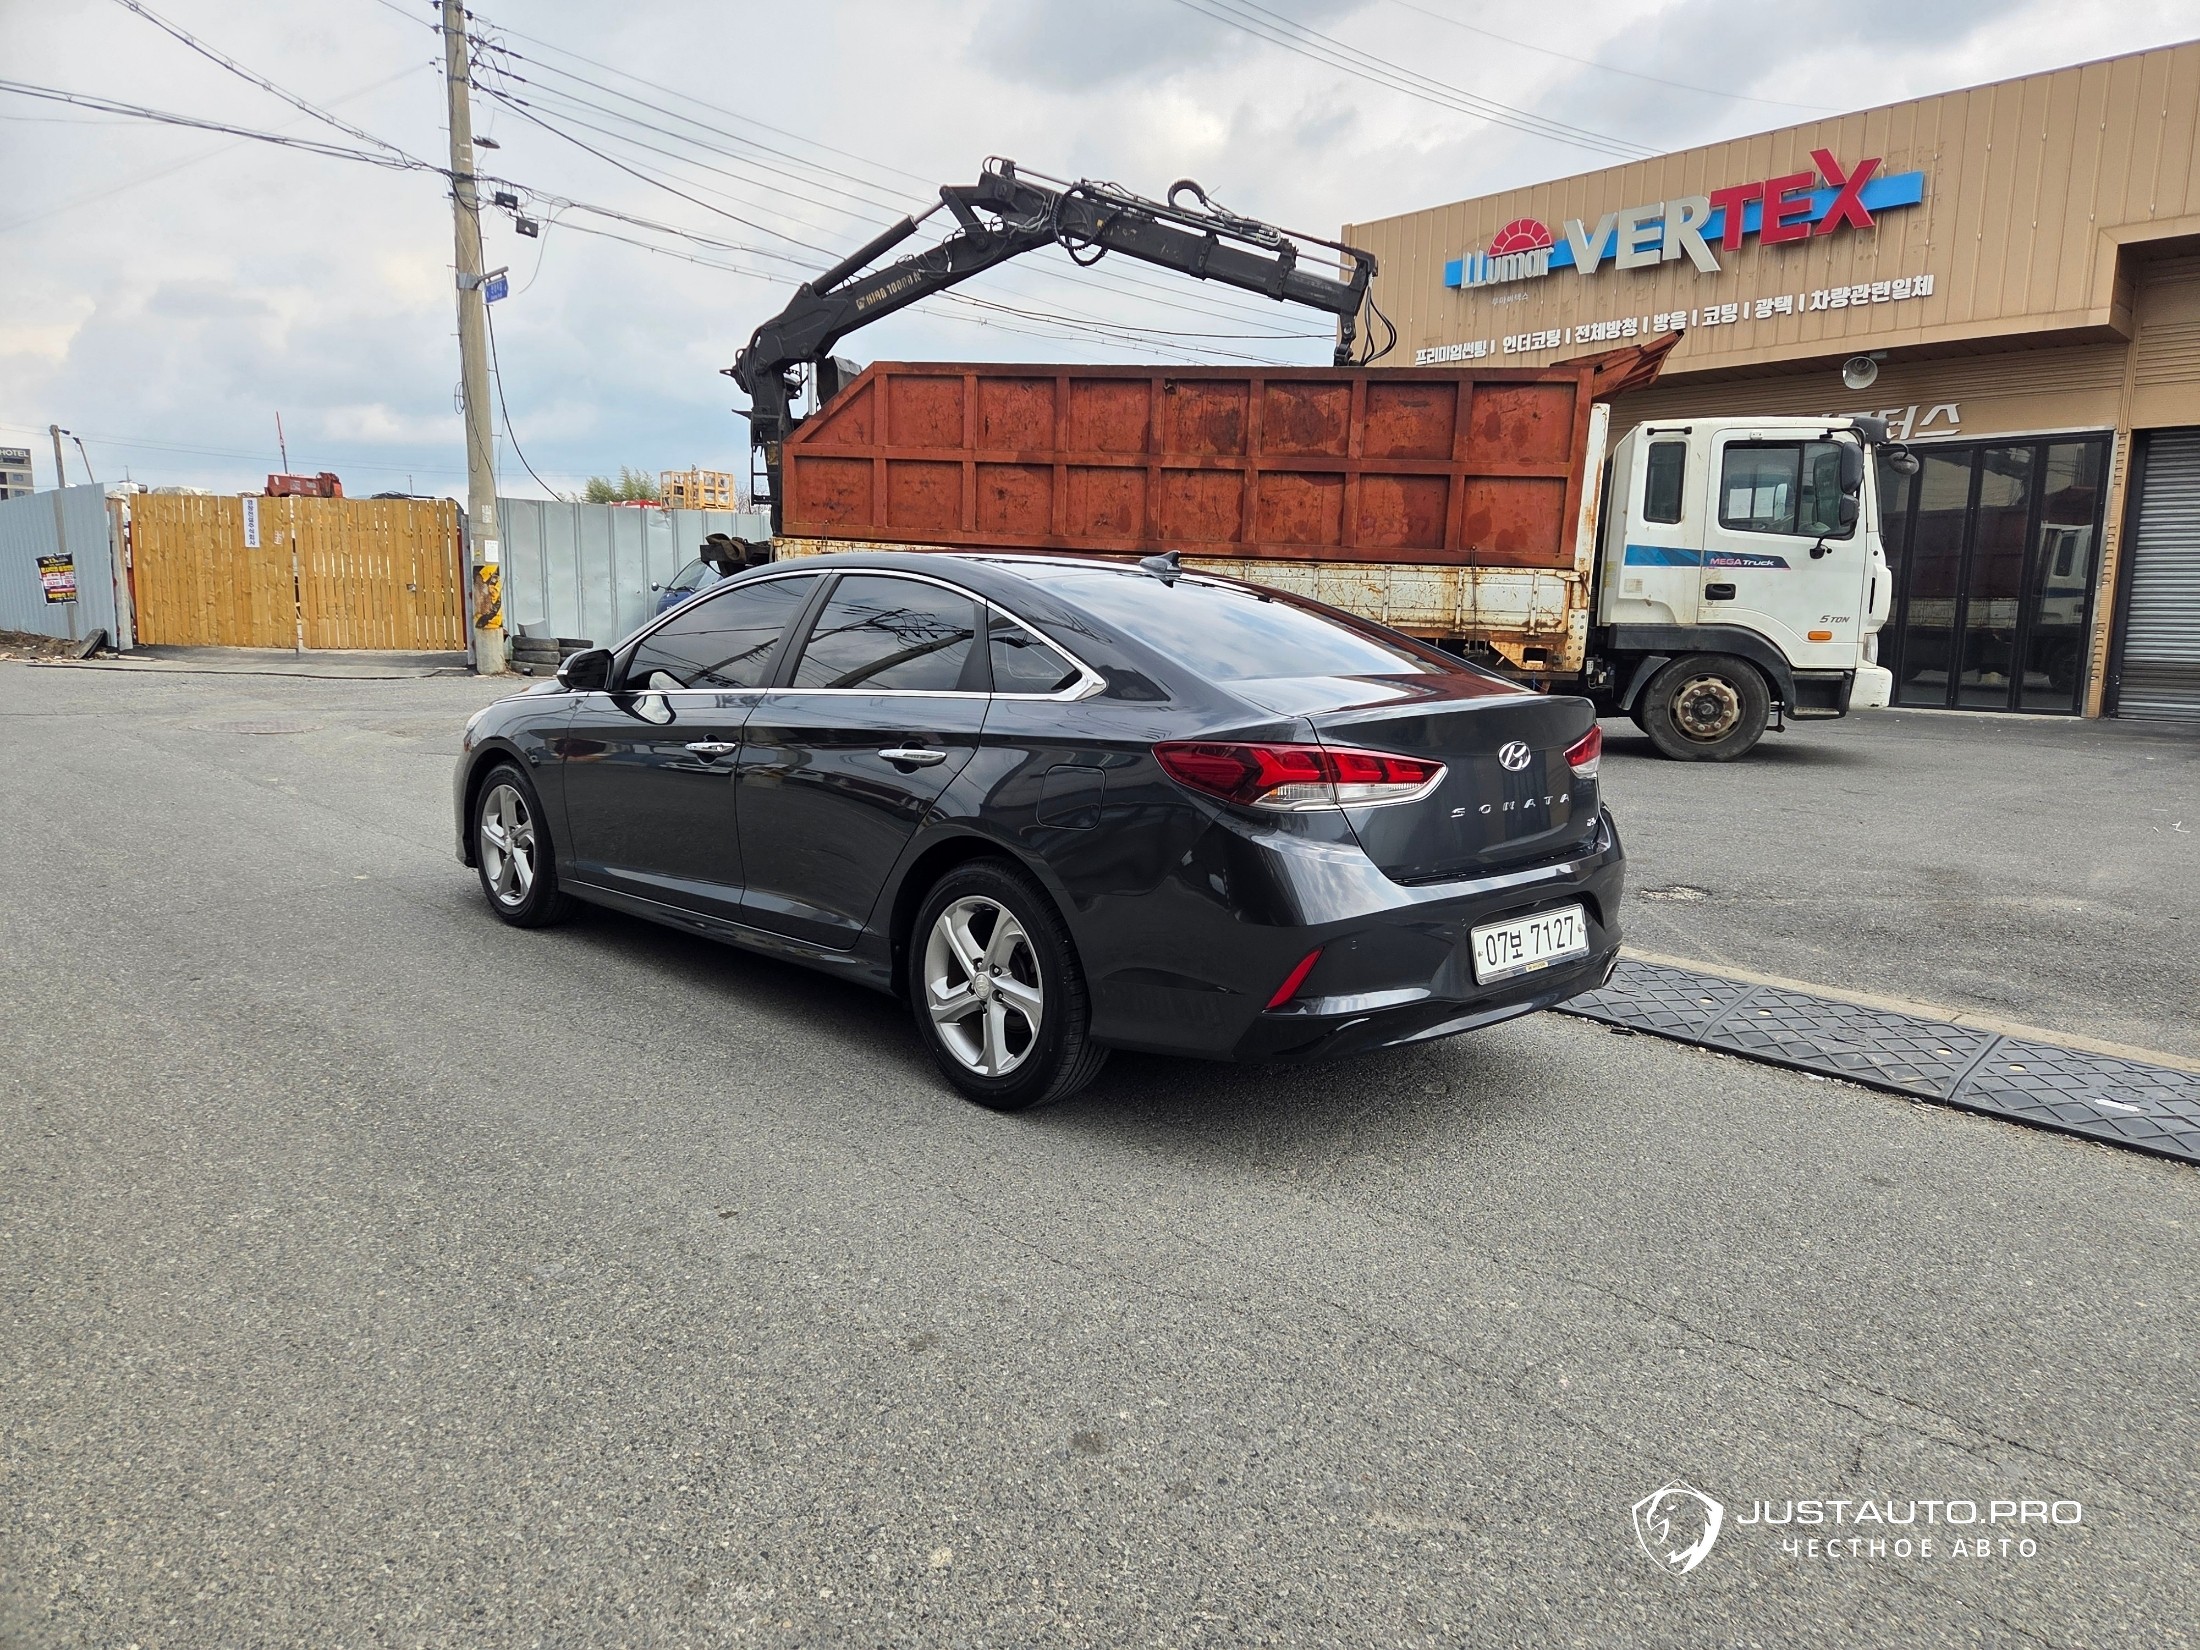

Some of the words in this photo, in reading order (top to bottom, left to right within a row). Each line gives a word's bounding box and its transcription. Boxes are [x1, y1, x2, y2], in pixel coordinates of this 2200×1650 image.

[1563, 148, 1883, 275] VERTEX
[1415, 340, 1487, 366] 프리미엄썬팅
[1575, 317, 1638, 344] 전체방청
[1653, 310, 1687, 333] 방음
[1702, 302, 1738, 327] 코팅
[1755, 294, 1793, 319] 광택
[1809, 274, 1935, 311] 차량관련일체
[0, 449, 29, 458] HOTEL
[1820, 615, 1829, 624] 5
[1830, 616, 1850, 624] TON
[1451, 793, 1570, 818] SONATA
[1485, 930, 1523, 966] 07보
[1530, 915, 1574, 955] 7127
